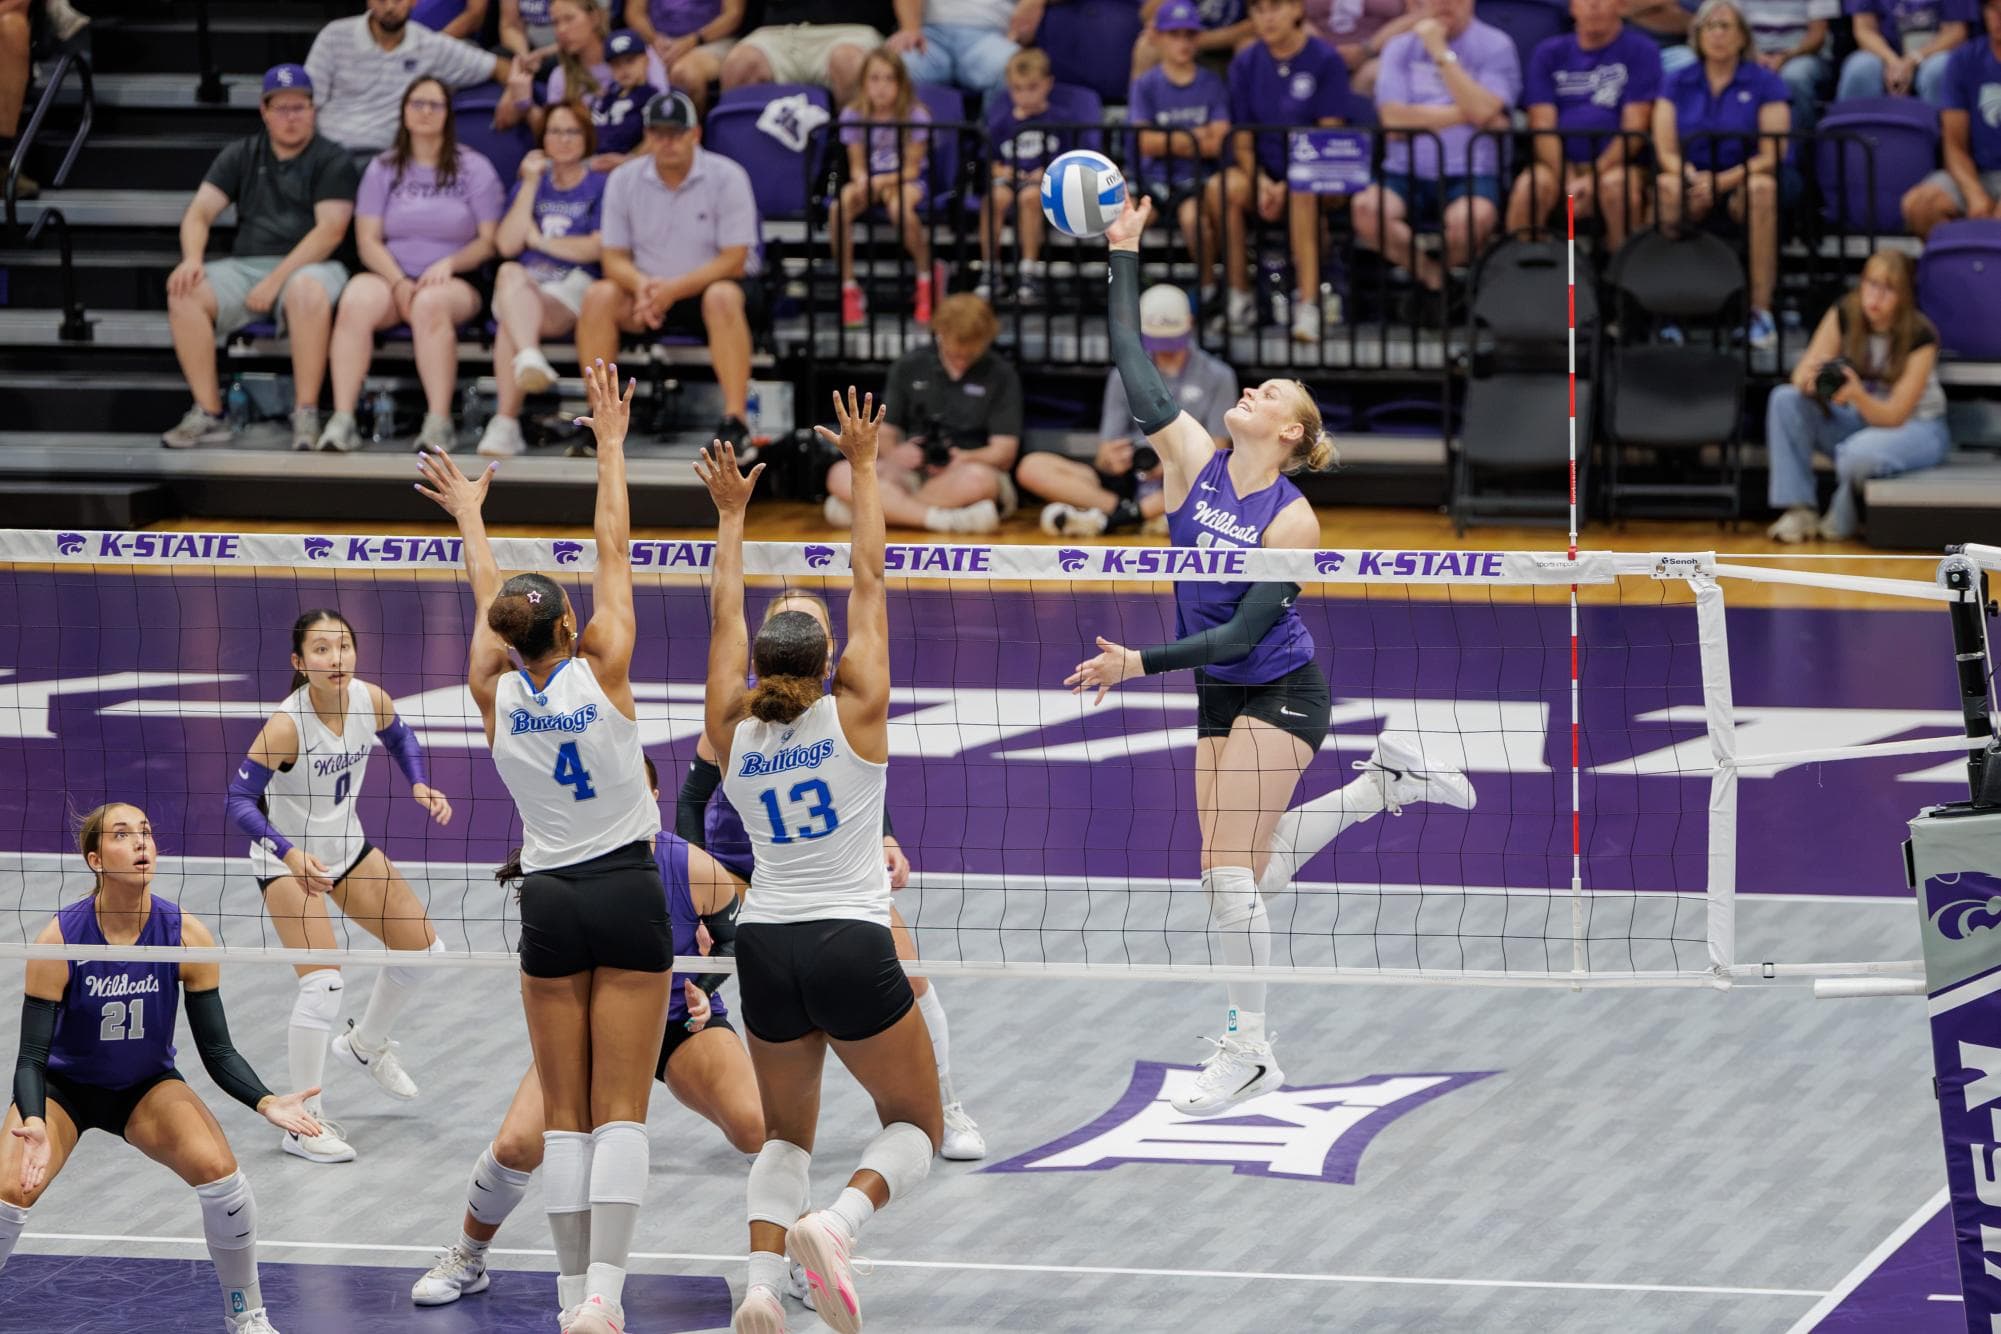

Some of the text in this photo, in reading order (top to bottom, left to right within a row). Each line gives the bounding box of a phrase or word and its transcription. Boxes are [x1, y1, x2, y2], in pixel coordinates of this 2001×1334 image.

[1192, 501, 1259, 544] Wildcats
[100, 533, 240, 558] K-STATE
[347, 537, 464, 562] K-STAT
[629, 542, 717, 567] STAT
[848, 546, 992, 572] STATE
[1102, 549, 1247, 574] K-STATE
[1358, 552, 1504, 577] K-STATE
[314, 744, 369, 777] Wildcat
[553, 740, 597, 802] 4
[335, 771, 351, 806] 0
[759, 778, 839, 843] 13
[85, 973, 159, 997] Wildcats
[100, 998, 144, 1041] 21
